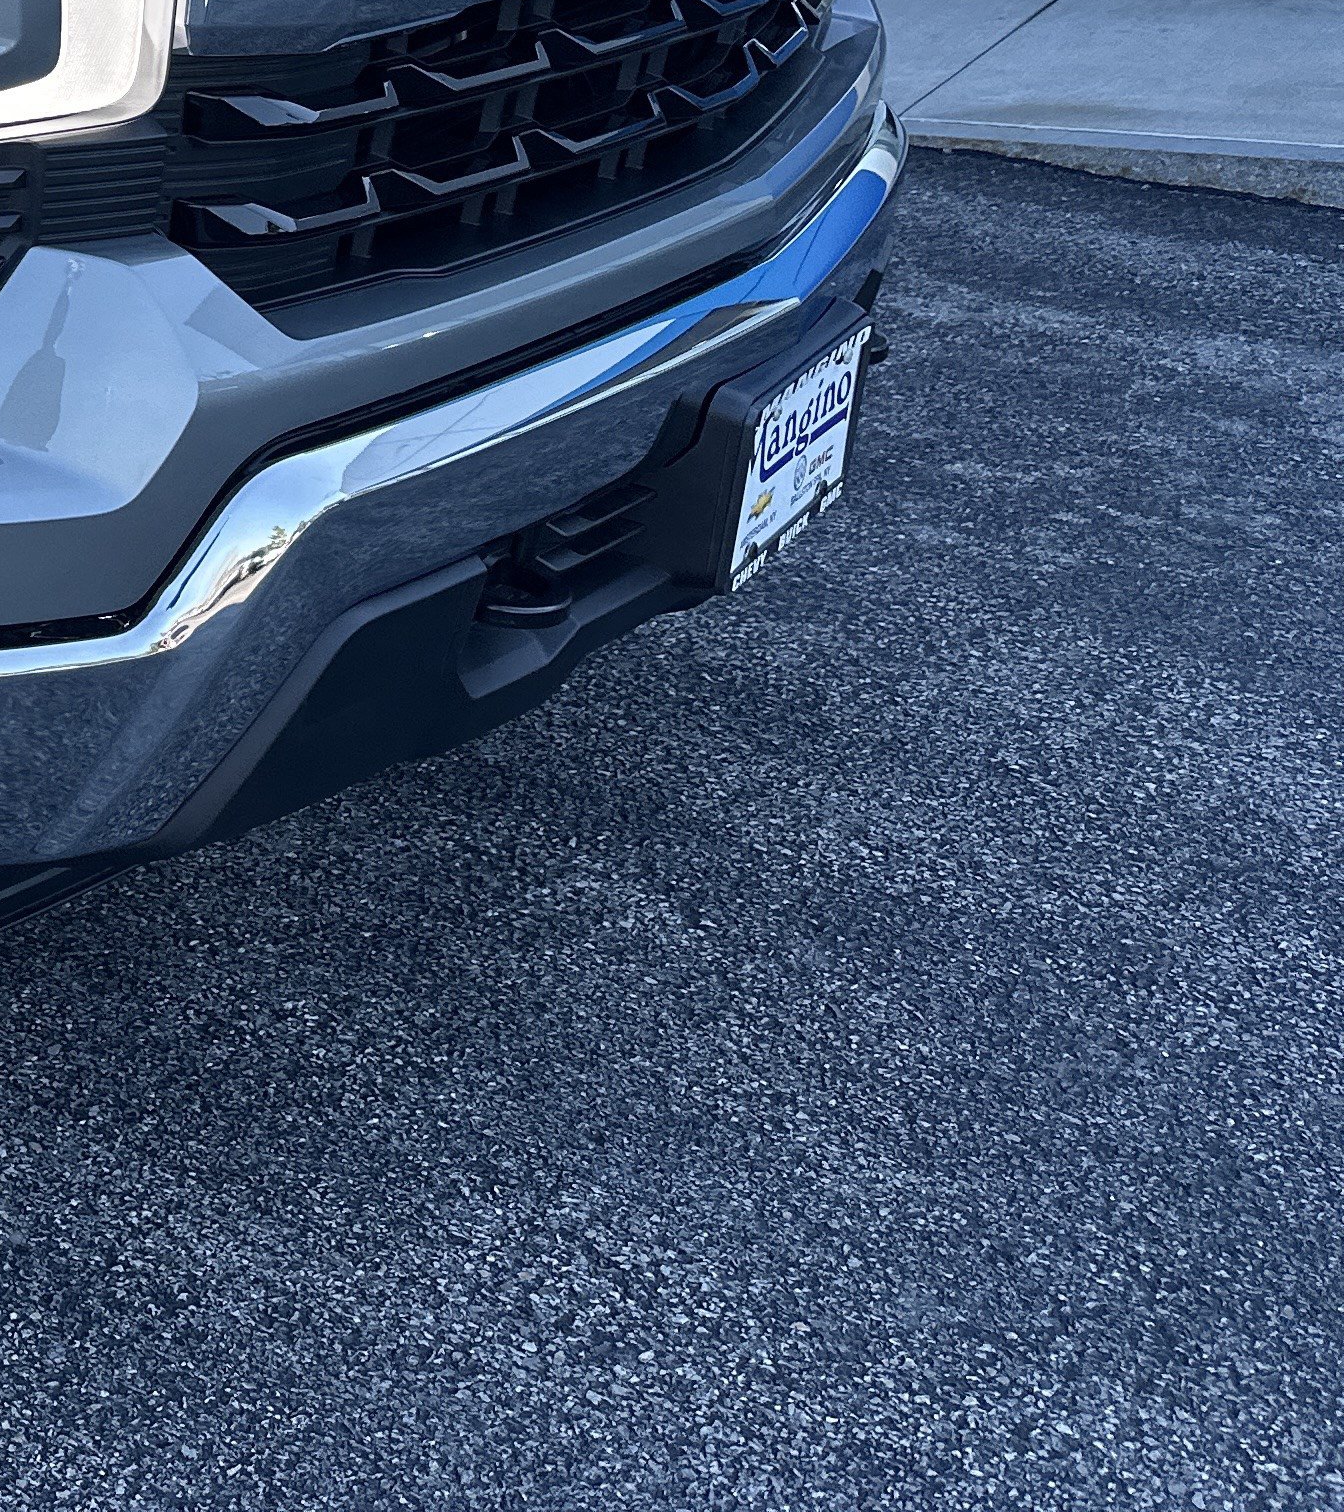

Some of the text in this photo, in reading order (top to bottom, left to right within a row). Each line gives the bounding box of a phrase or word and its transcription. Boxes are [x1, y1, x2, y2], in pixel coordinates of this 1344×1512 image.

[808, 444, 834, 476] GMC
[731, 480, 845, 592] CHEVY BUICK GMC
